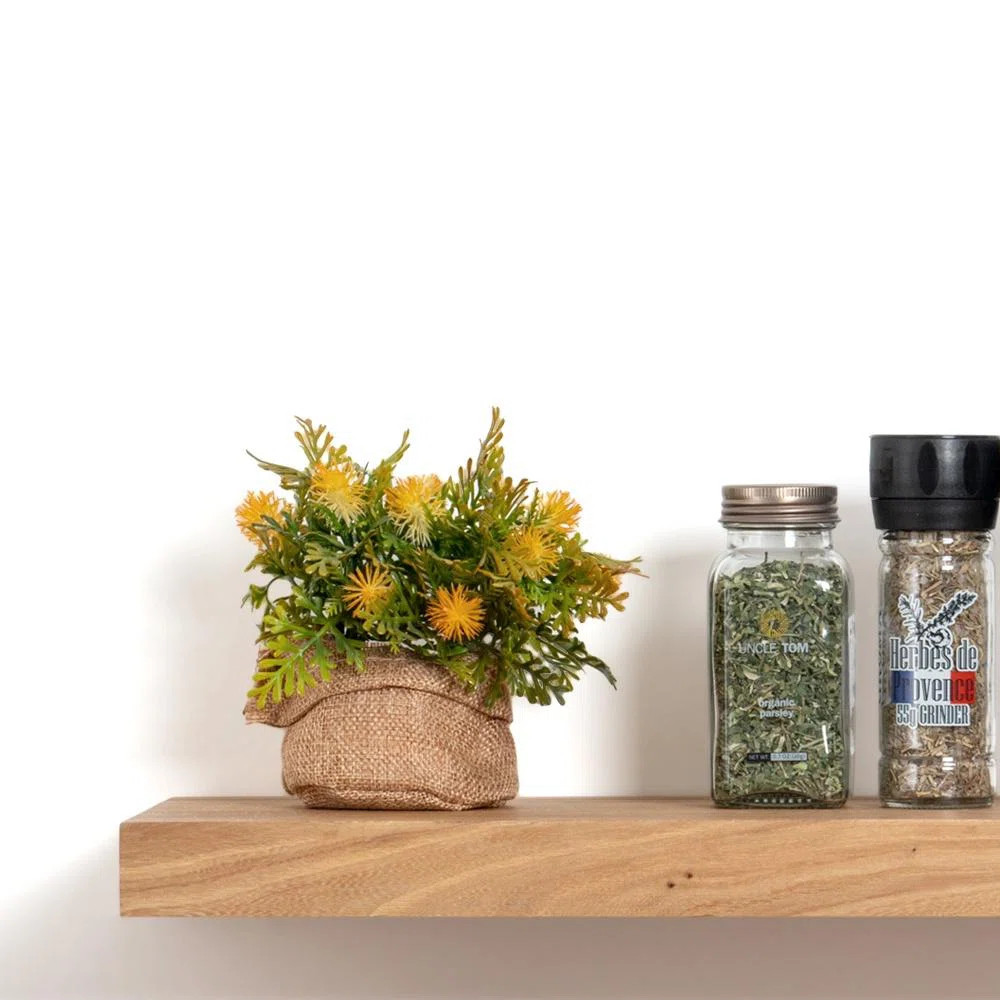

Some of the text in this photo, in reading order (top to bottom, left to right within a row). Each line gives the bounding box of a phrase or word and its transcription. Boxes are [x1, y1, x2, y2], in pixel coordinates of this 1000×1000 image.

[738, 642, 809, 654] UNCLE TOM
[890, 637, 977, 670] Herbes de
[893, 671, 976, 703] Provence
[758, 697, 796, 709] organic
[760, 709, 793, 719] parsley
[896, 704, 969, 727] 55g GRINDER
